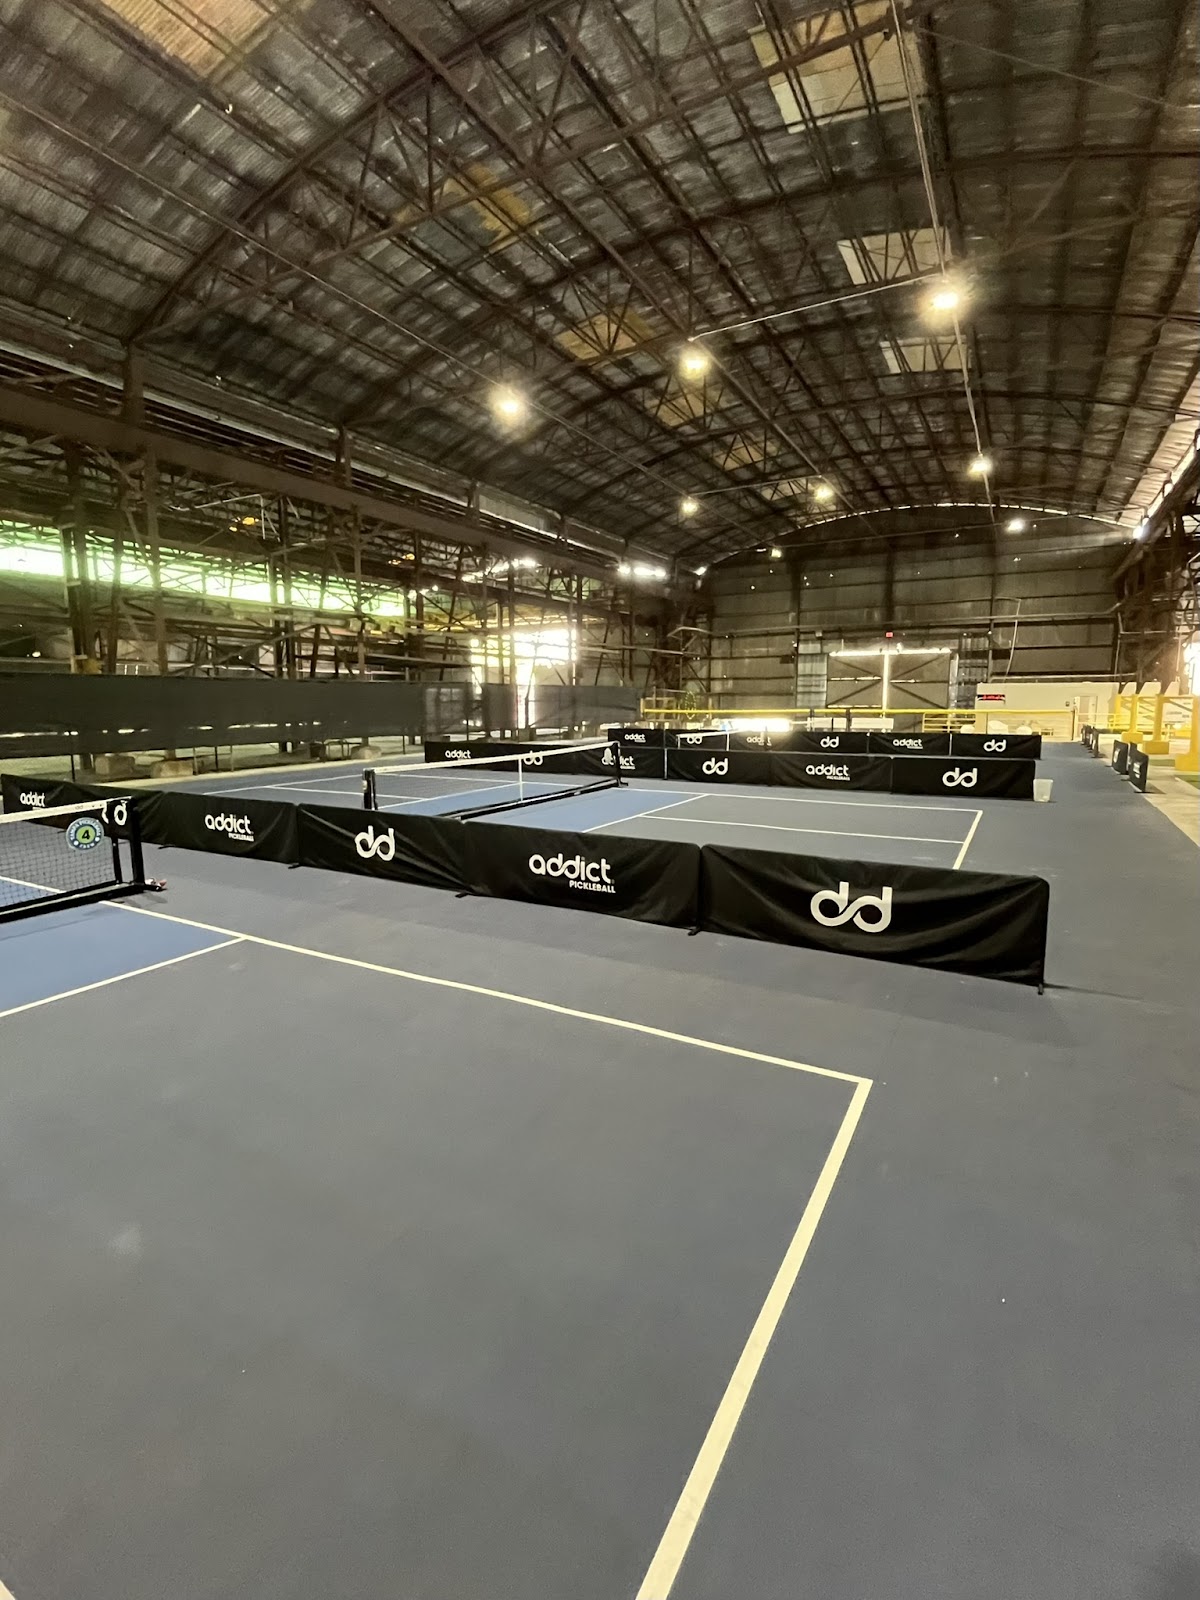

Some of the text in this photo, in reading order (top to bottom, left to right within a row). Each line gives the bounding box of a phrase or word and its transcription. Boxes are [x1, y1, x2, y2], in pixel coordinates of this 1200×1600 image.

[892, 739, 922, 747] addict
[445, 750, 471, 759] addict
[805, 764, 849, 776] addict
[20, 791, 45, 807] addict
[204, 812, 251, 834] addict
[81, 829, 91, 840] 4
[528, 853, 611, 884] addict
[569, 879, 616, 894] PICKLEBALL
